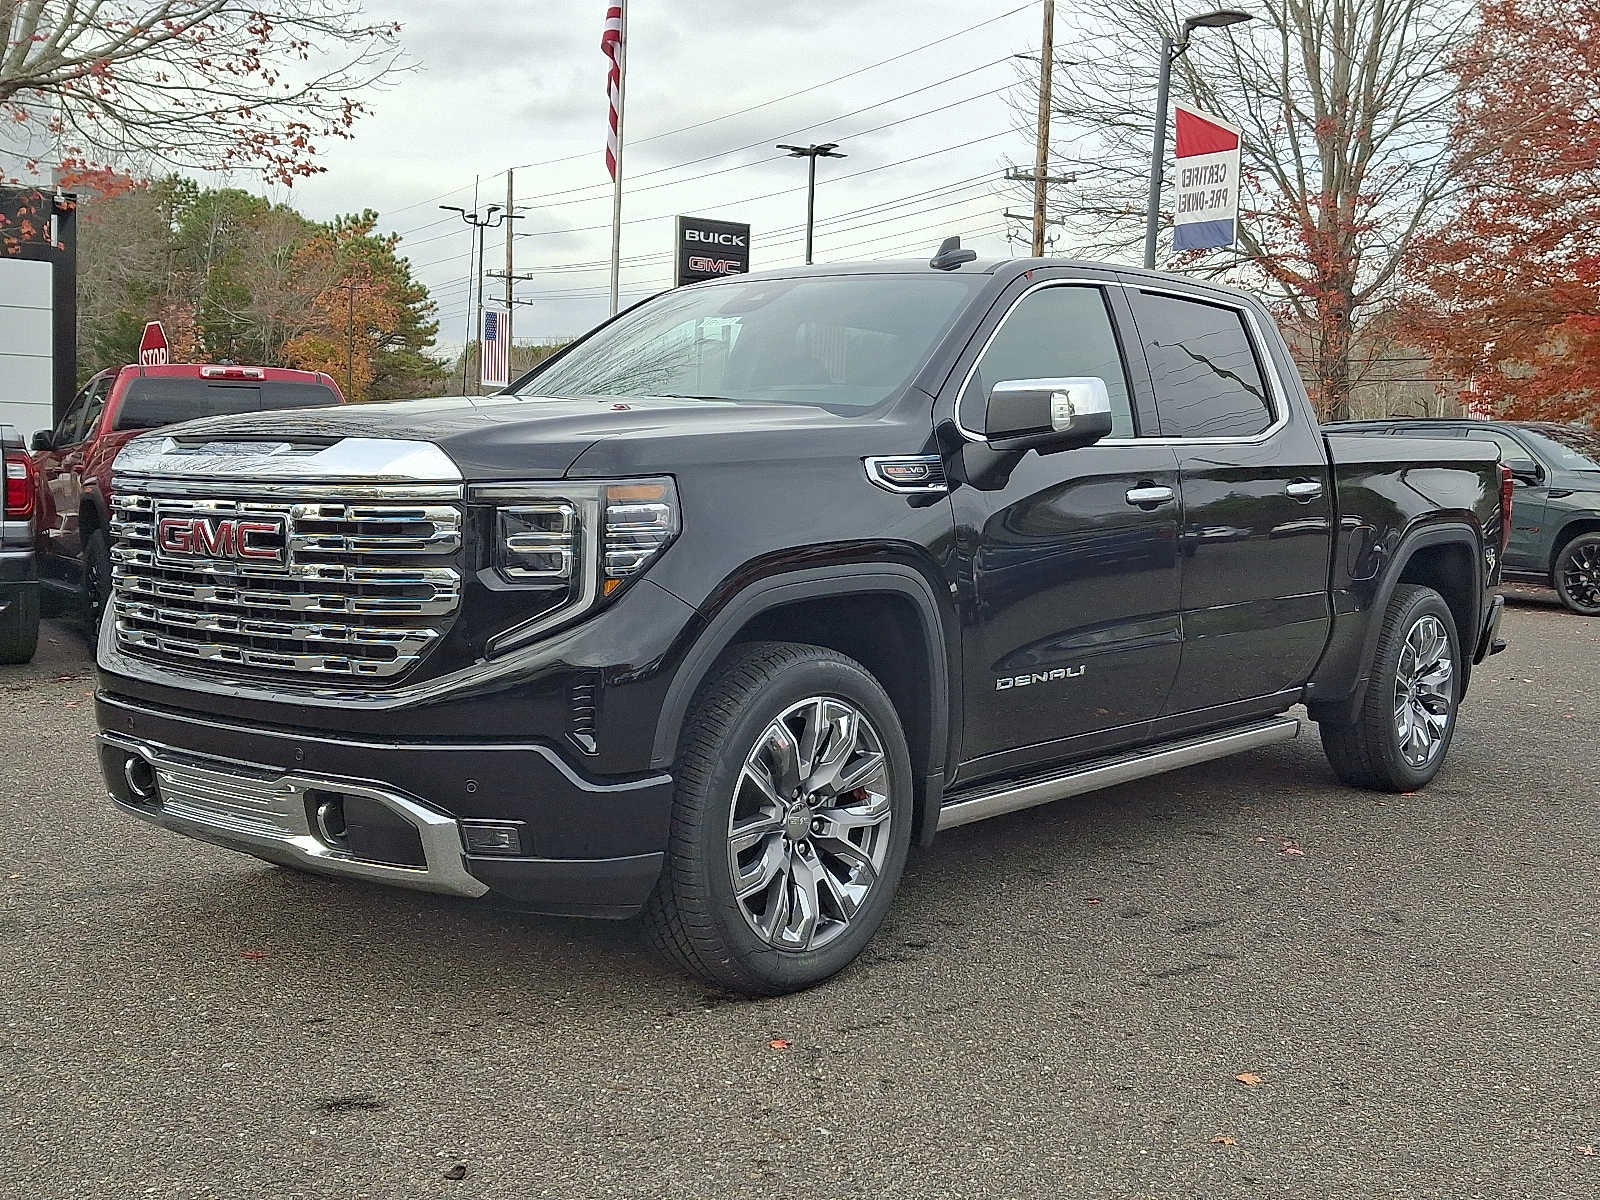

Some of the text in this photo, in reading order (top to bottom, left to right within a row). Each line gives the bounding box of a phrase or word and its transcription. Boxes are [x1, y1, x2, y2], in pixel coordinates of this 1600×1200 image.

[685, 229, 745, 247] BUICK
[688, 256, 741, 275] GMC
[142, 347, 167, 366] STOP
[160, 518, 282, 561] GMC
[996, 664, 1086, 691] DENALI
